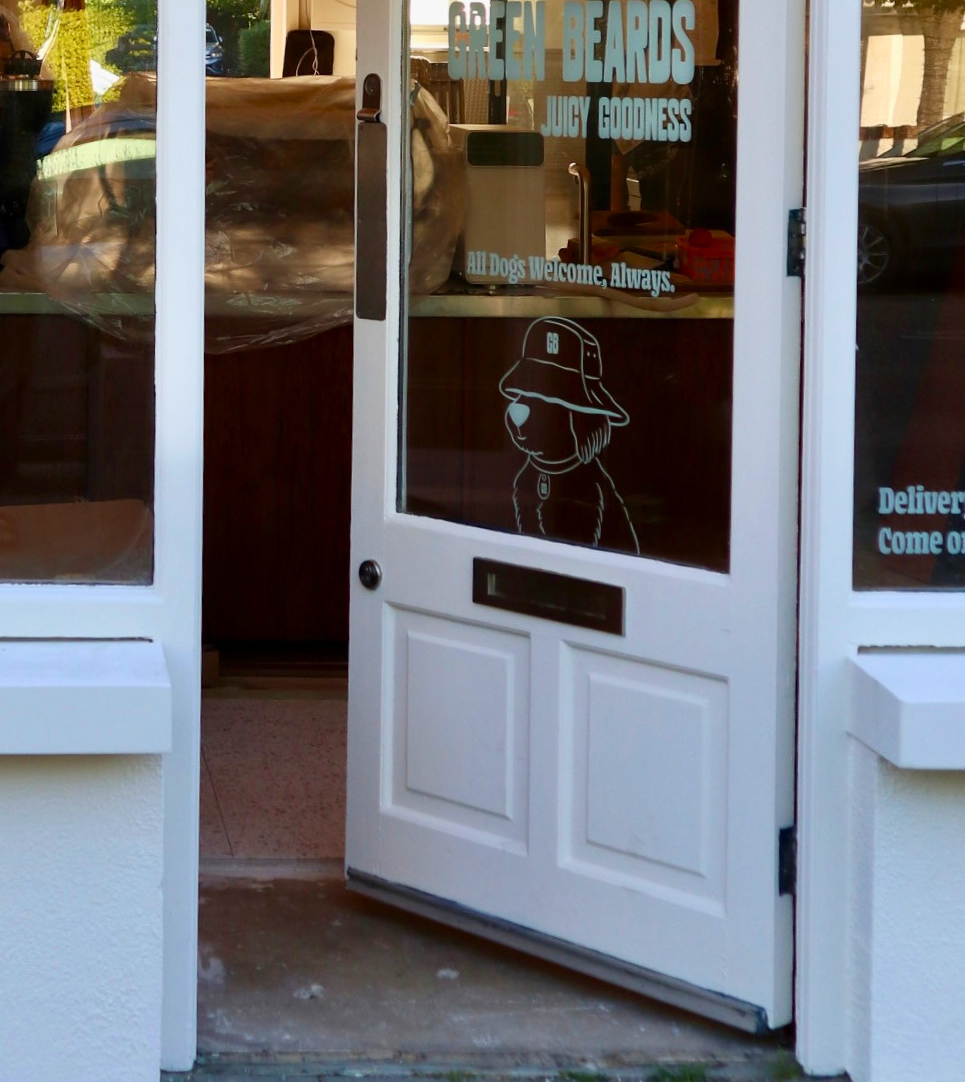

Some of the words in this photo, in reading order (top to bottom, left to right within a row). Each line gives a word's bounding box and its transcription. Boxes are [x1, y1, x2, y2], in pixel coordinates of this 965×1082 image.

[447, 0, 546, 82] GREEN
[562, 0, 695, 85] BEARDS
[540, 95, 591, 139] JUICY
[598, 96, 692, 143] GOODNESS
[467, 251, 486, 275] All
[528, 255, 607, 289] Welcome,
[610, 262, 676, 297] Always.
[546, 331, 560, 355] GB
[878, 485, 965, 520] Deliver
[878, 527, 944, 555] Come
